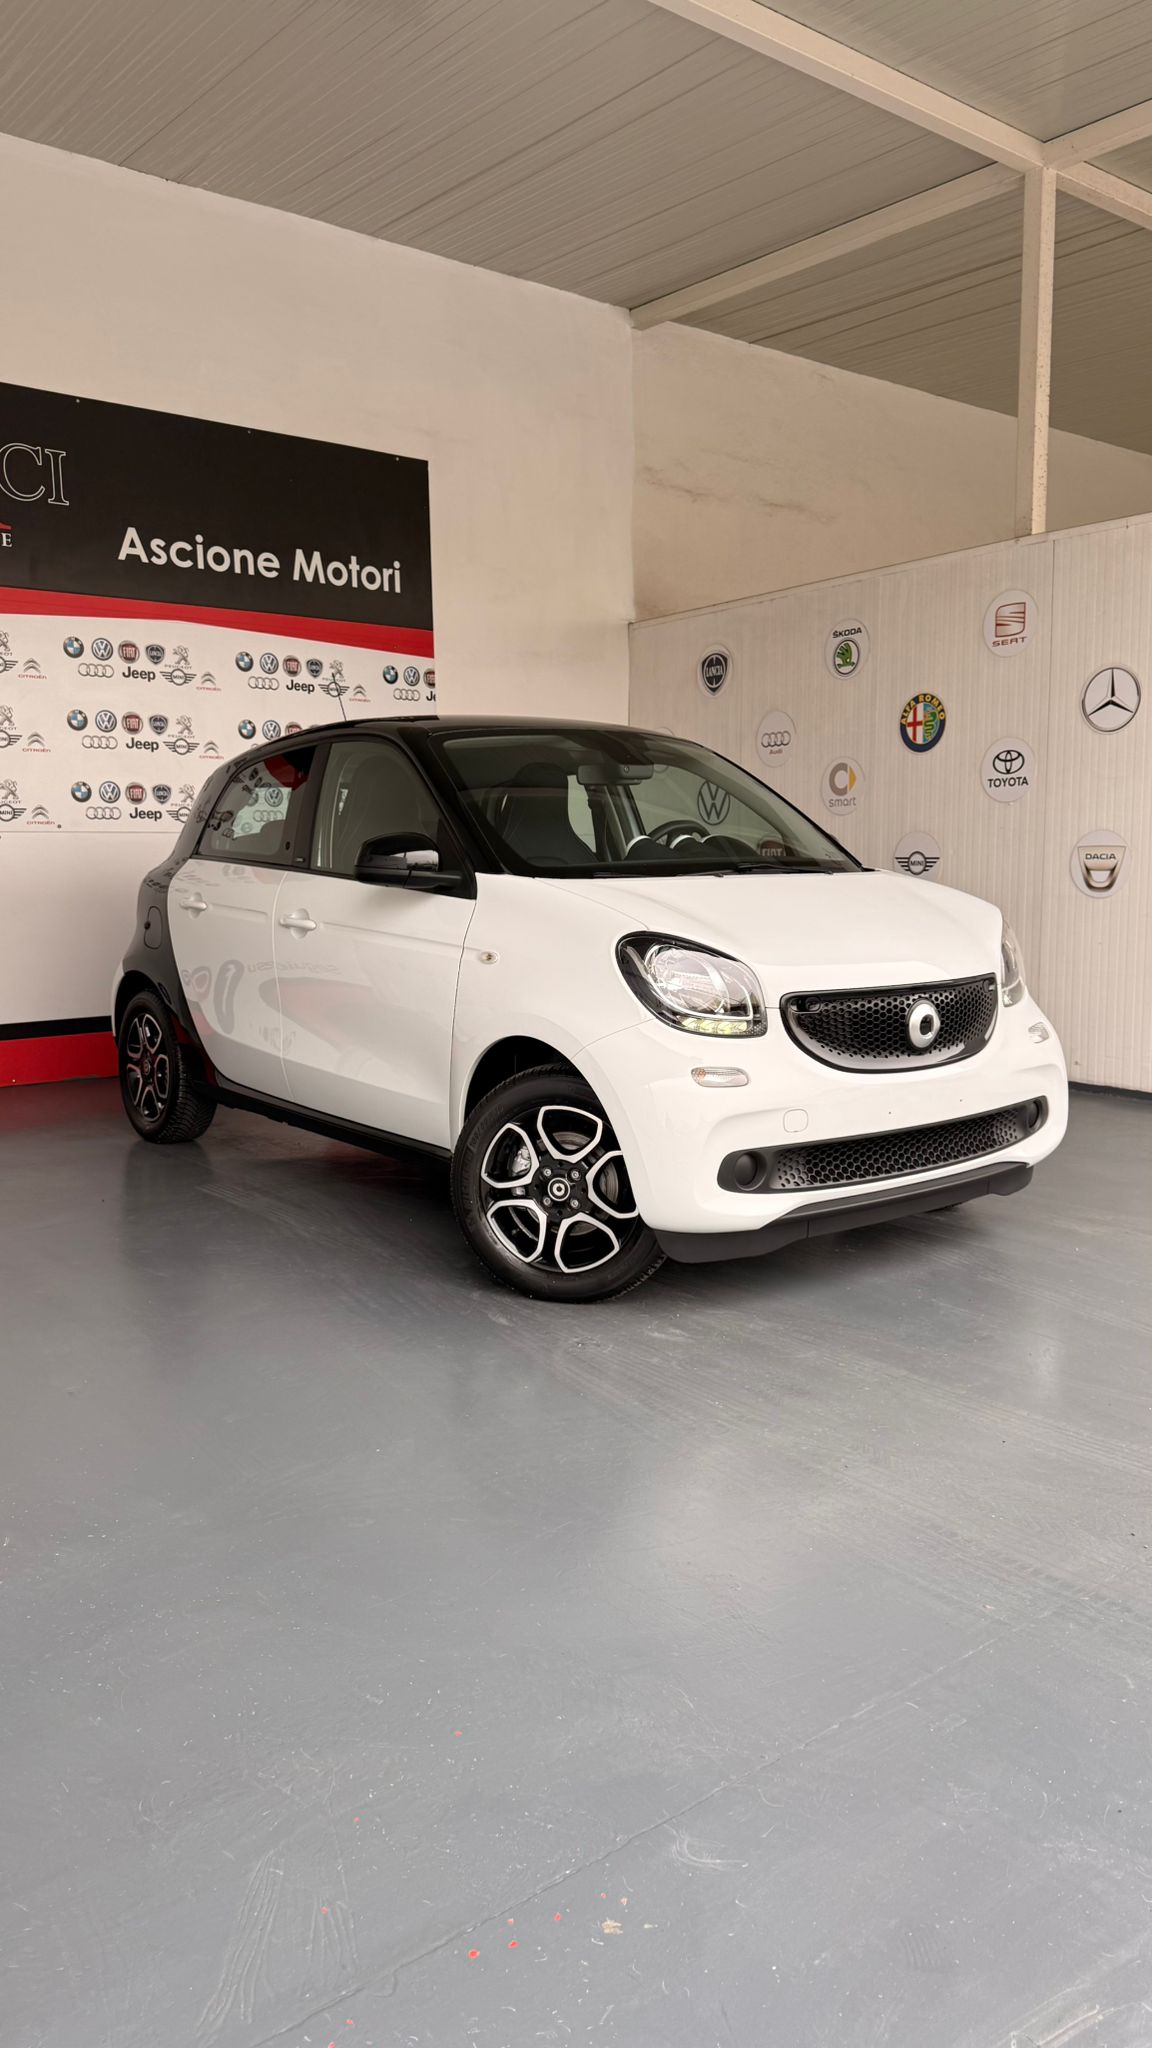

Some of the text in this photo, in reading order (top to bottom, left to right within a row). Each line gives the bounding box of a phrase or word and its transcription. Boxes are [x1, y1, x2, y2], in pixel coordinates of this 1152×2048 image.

[118, 526, 401, 594] Ascione Motori
[991, 636, 1028, 648] SEAT
[122, 665, 156, 683] Jeep
[286, 679, 315, 694] Jeep
[918, 694, 945, 720] ROMEO
[126, 737, 159, 753] Jeep
[987, 776, 1029, 788] TOYOTA
[828, 797, 857, 808] smart
[129, 806, 163, 822] Jeep
